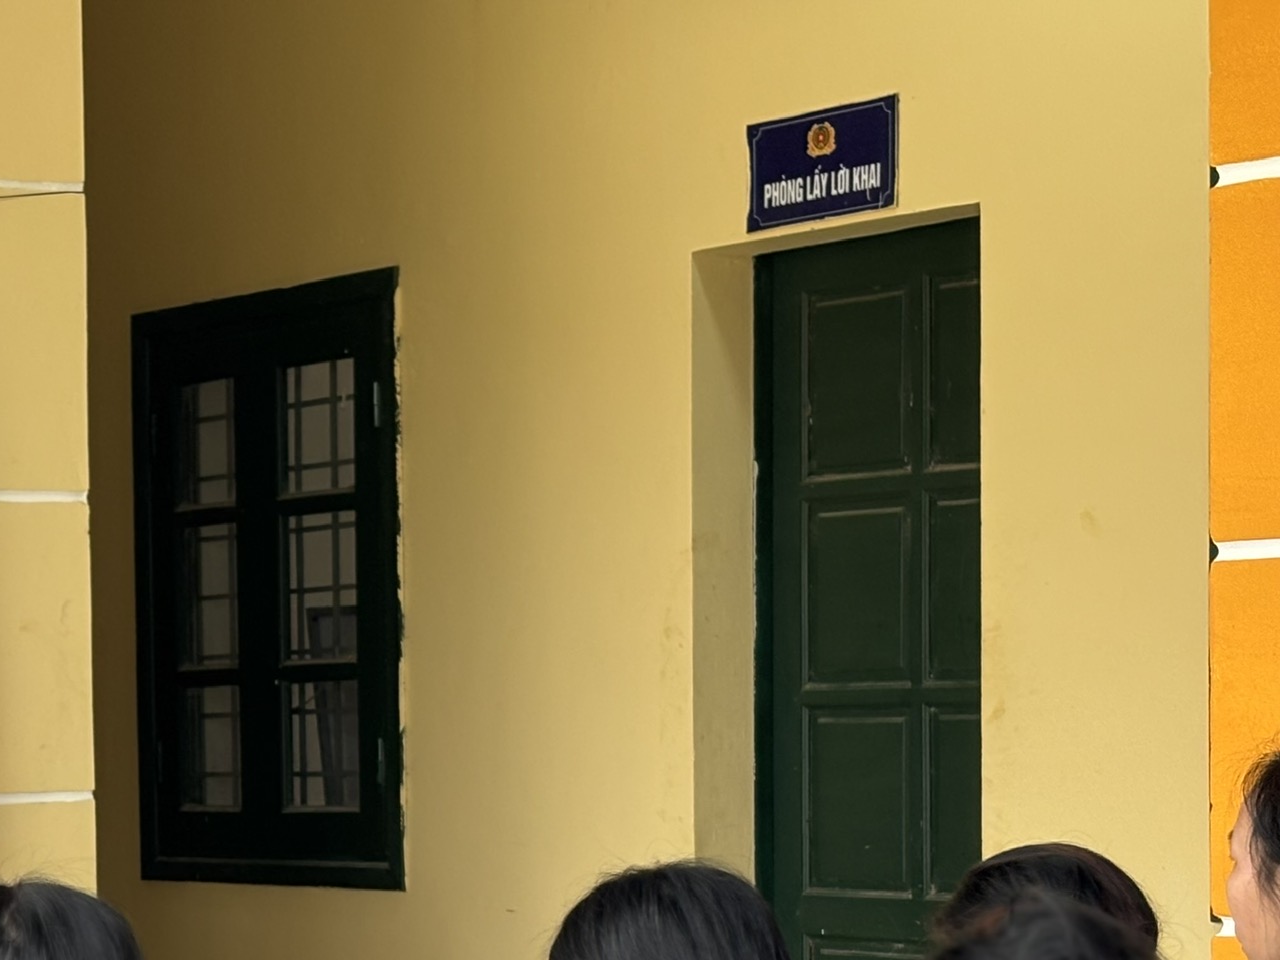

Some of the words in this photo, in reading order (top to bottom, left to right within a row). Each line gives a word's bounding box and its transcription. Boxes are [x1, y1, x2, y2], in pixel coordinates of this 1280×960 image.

[763, 174, 804, 209] PHÒNG
[806, 164, 829, 201] LẤY
[830, 163, 850, 196] LỜI
[852, 162, 881, 192] KHAI
